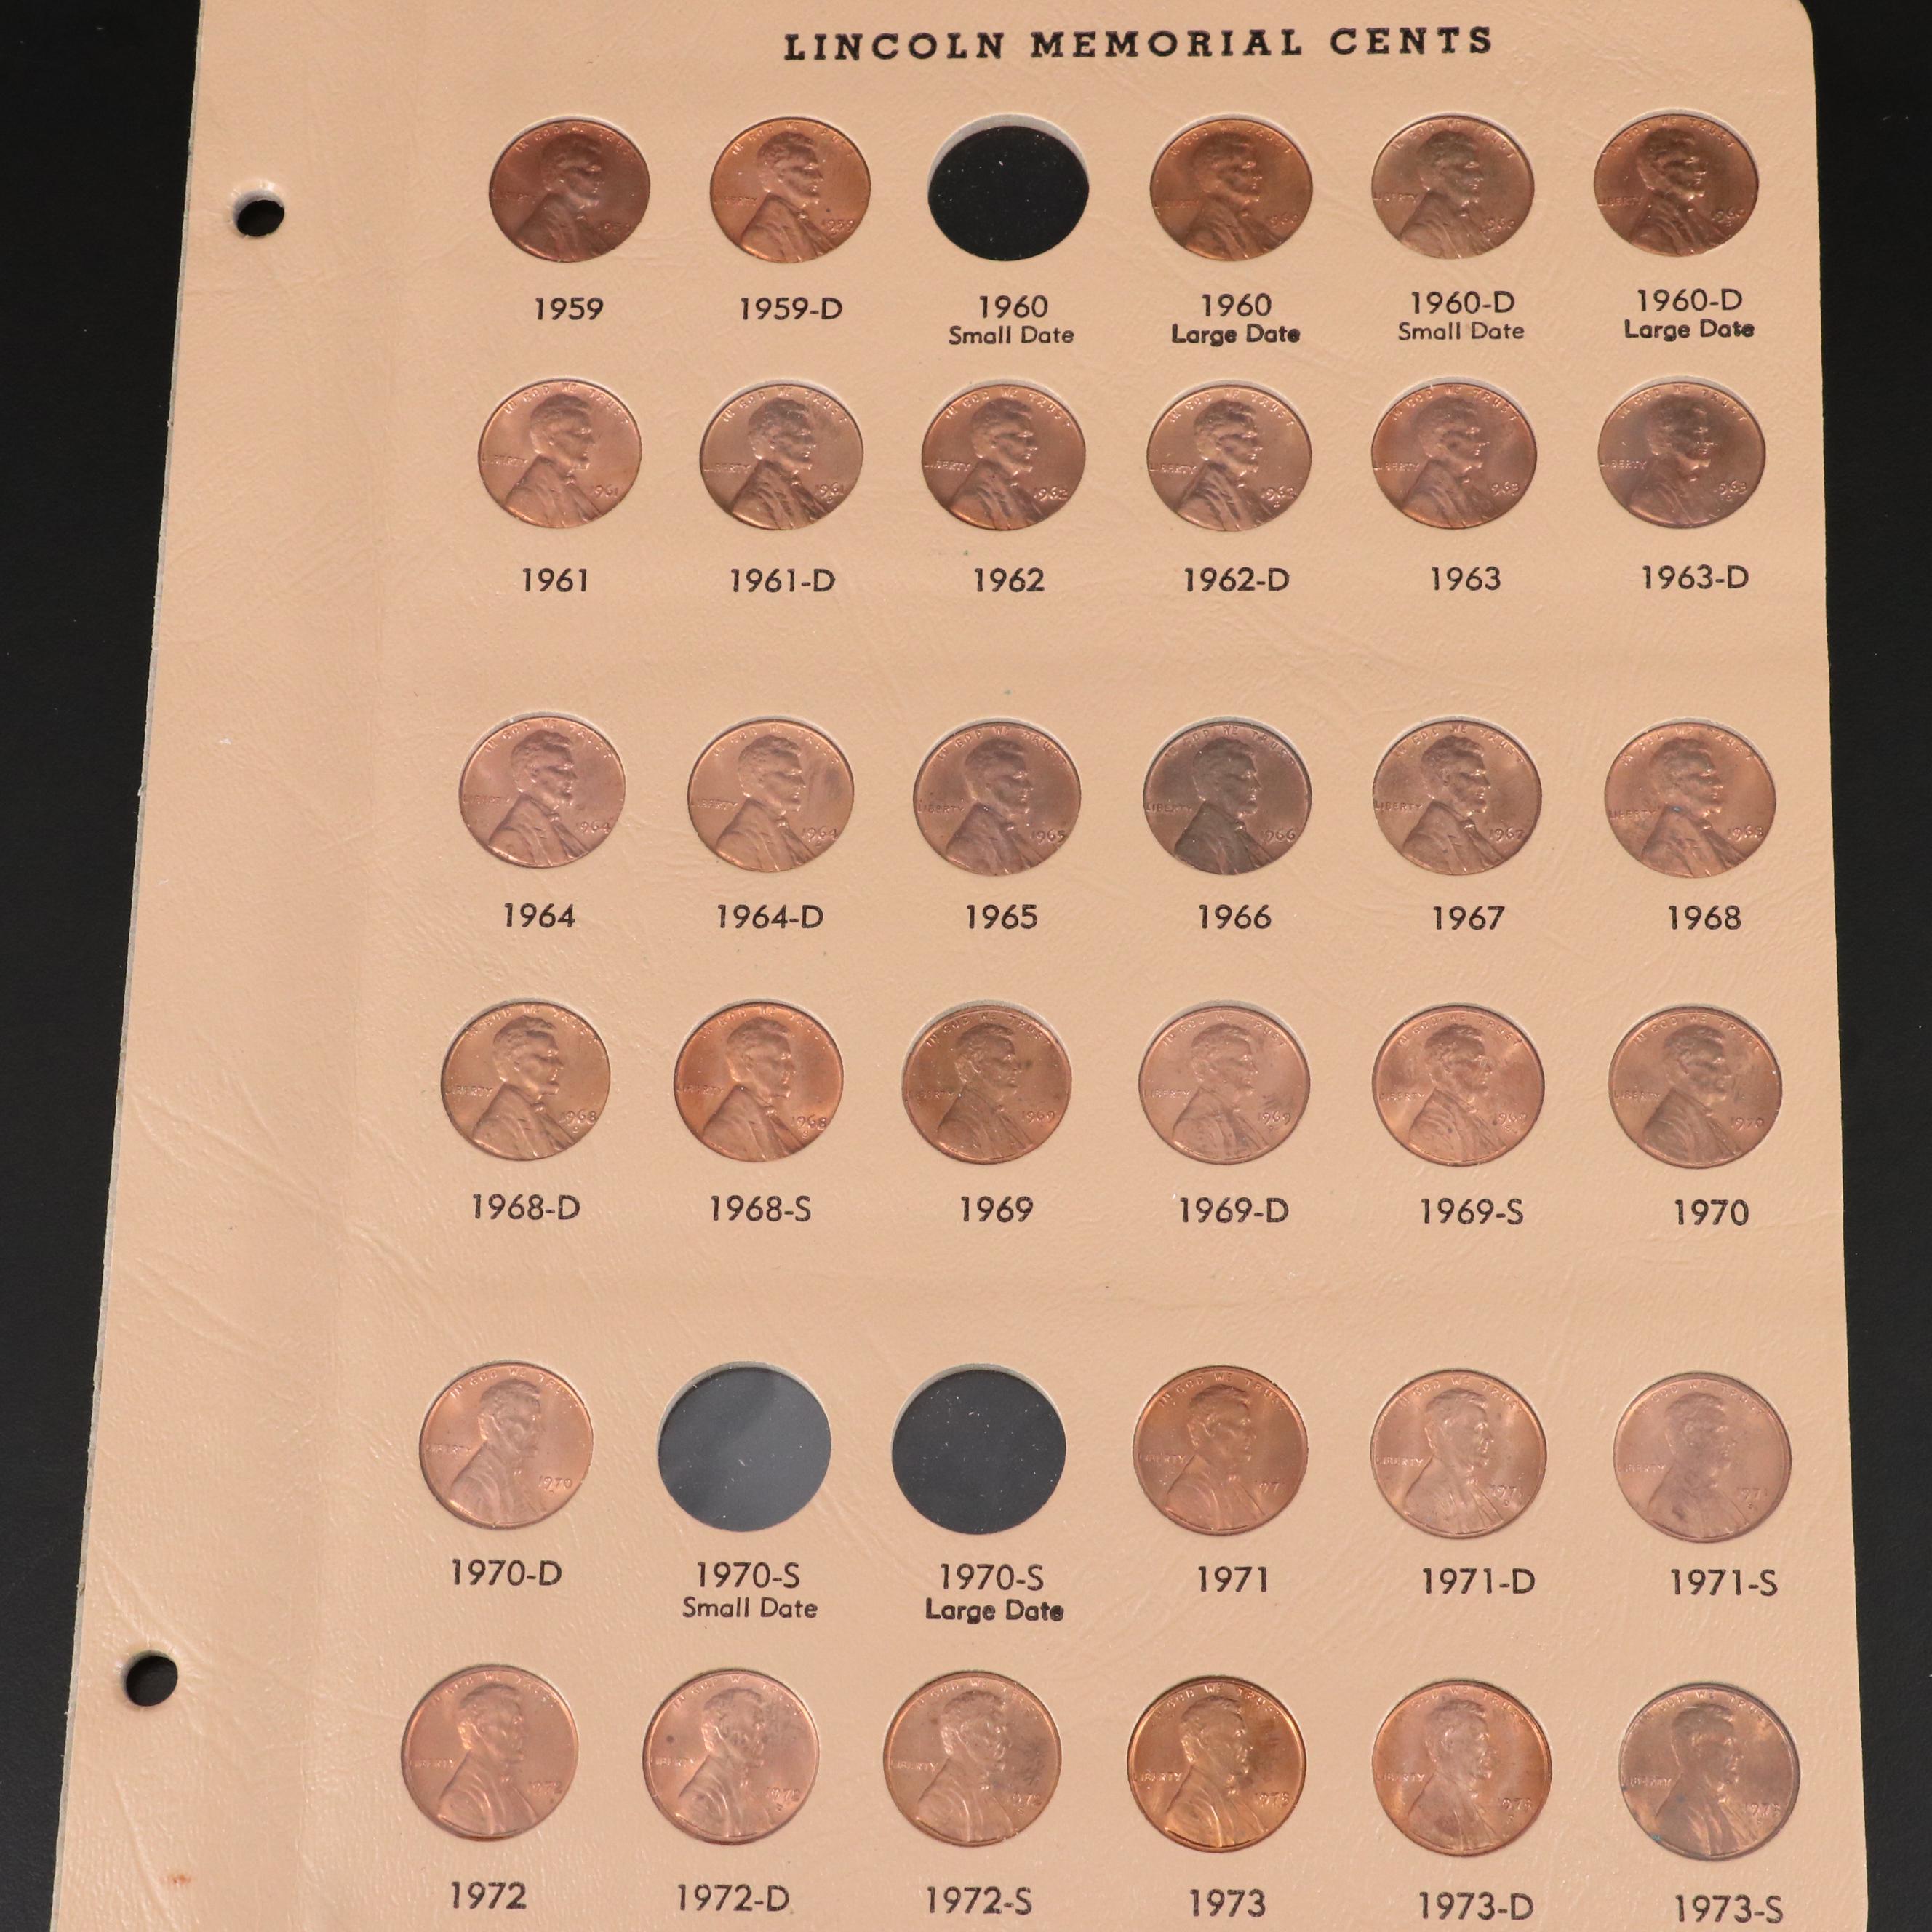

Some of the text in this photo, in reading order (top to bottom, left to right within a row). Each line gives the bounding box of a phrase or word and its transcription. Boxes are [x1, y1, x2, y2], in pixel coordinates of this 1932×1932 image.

[785, 26, 1490, 60] LINCOLN MEMORIAL CENTS
[535, 297, 604, 321] 1959
[741, 296, 843, 321] 1959-D
[979, 295, 1048, 319] 1960
[1202, 292, 1272, 317] 1960
[1411, 290, 1515, 314] 1960-D
[1637, 288, 1743, 312] 1960-D
[949, 325, 1074, 346] Small Date
[1171, 323, 1301, 348] Large Date
[1398, 321, 1525, 341] Small Date
[1624, 319, 1755, 343] Large Date
[522, 567, 587, 593] 1961
[730, 568, 836, 593] 1961-D
[974, 567, 1045, 593] 1962
[1184, 567, 1290, 592] 1962-D
[1431, 566, 1501, 591] 1963
[1642, 564, 1749, 590] 1963-D
[802, 827, 839, 840] 1964
[1029, 829, 1066, 843] 1965
[1261, 829, 1296, 841] 1966
[1488, 829, 1526, 841] 1967
[504, 903, 575, 928] 1964
[717, 904, 823, 929] 1964-D
[966, 904, 1038, 930] 1965
[1199, 903, 1272, 930] 1966
[1433, 906, 1506, 930] 1967
[1669, 905, 1741, 930] 1968
[560, 1111, 598, 1125] 1968
[790, 1115, 829, 1130] 1968
[1019, 1109, 1056, 1123] 1969
[1256, 1111, 1292, 1125] 1969
[1494, 1111, 1528, 1125] 1969
[1731, 1116, 1764, 1130] 1970
[473, 1194, 580, 1221] 1968-D
[711, 1194, 811, 1222] 1968-S
[961, 1196, 1034, 1223] 1969
[1180, 1197, 1289, 1224] 1969-D
[1421, 1197, 1524, 1225] 1969-S
[1674, 1199, 1749, 1226] 1970
[538, 1474, 575, 1490] 1970
[452, 1558, 562, 1586] 1970-D
[698, 1561, 800, 1589] 1970-S
[941, 1563, 1044, 1592] 1970-S
[1198, 1565, 1267, 1592] 1971
[1422, 1568, 1536, 1594] 1971-D
[1671, 1568, 1779, 1597] 1971-S
[682, 1596, 818, 1618] Small Date
[925, 1597, 1064, 1625] Large Date
[451, 1881, 527, 1909] 1972
[678, 1884, 789, 1912] 1972-D
[927, 1886, 1032, 1915] 1972-S
[1190, 1888, 1266, 1917] 1973
[1419, 1891, 1533, 1920] 1973-D
[1675, 1894, 1783, 1924] 1973-S
